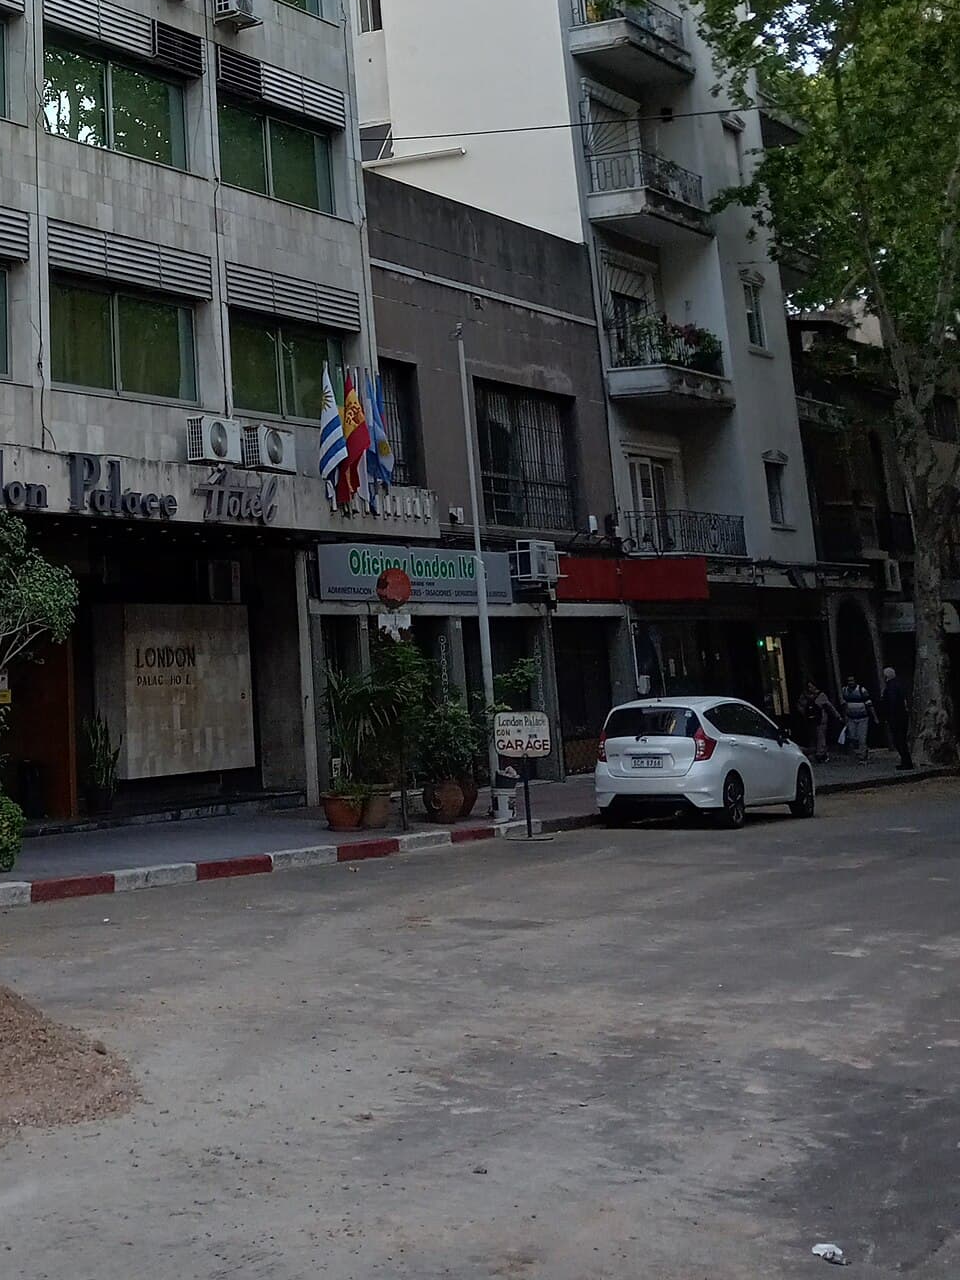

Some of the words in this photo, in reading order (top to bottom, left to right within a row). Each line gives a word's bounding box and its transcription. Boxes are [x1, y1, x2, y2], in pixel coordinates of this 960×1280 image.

[69, 452, 178, 518] Palace
[135, 645, 196, 668] LONDON
[496, 739, 550, 751] GARAGE
